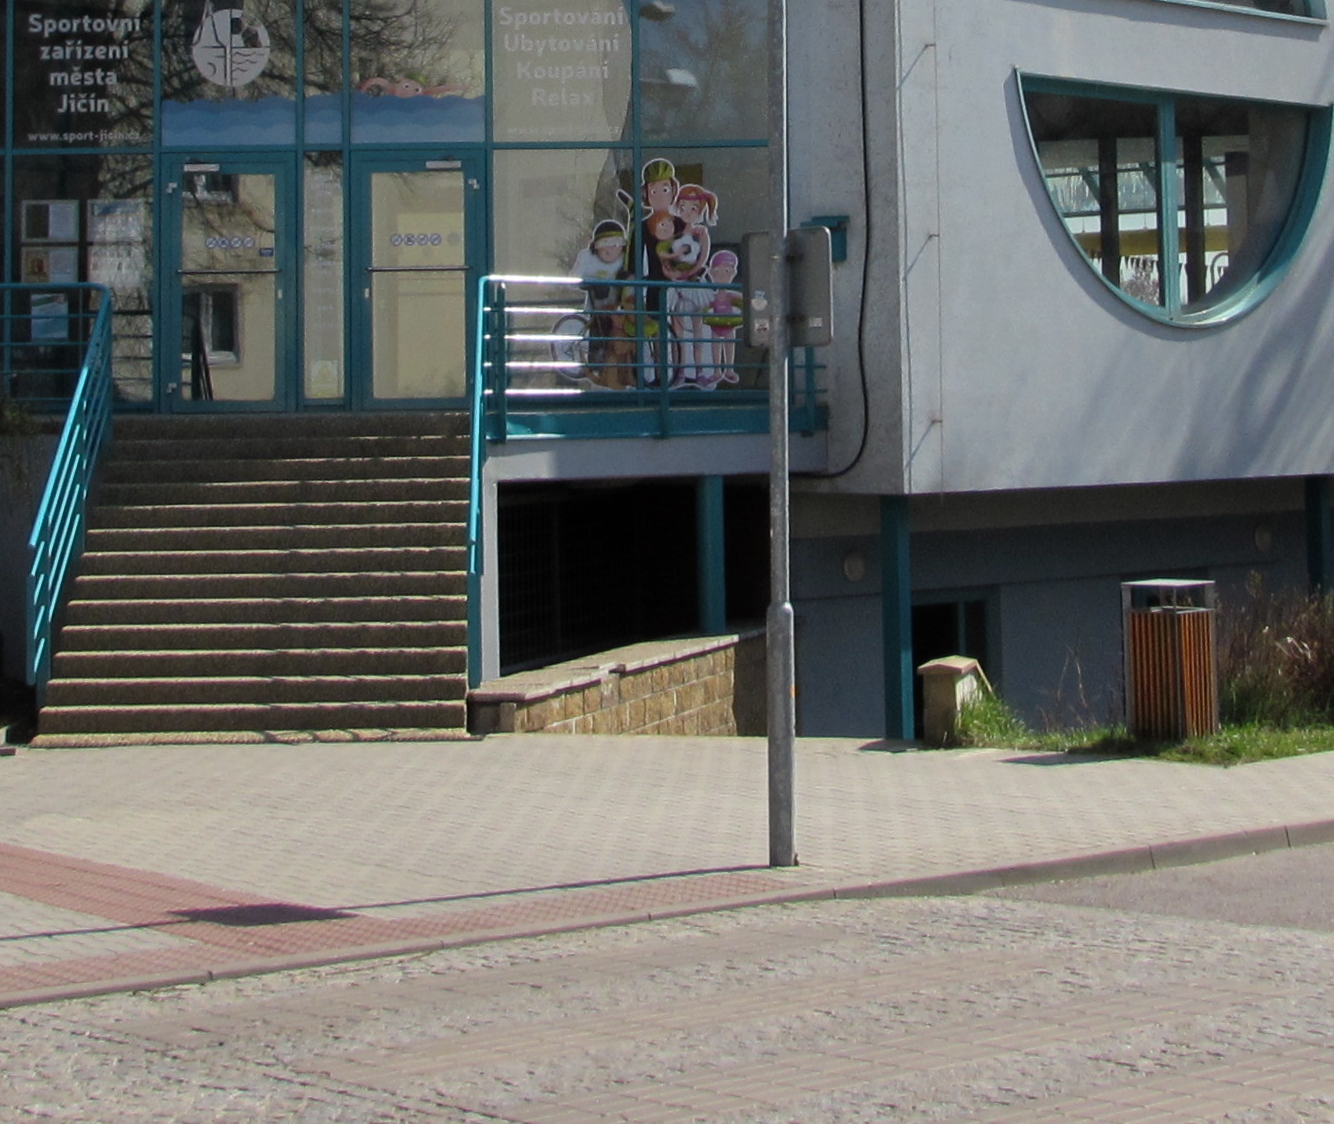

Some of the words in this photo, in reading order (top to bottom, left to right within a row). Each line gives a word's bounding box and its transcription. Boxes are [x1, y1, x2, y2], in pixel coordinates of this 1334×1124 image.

[28, 13, 141, 38] Sportovní
[498, 5, 625, 30] Sportování
[40, 39, 129, 60] zařízení
[504, 33, 620, 57] Ubytování
[49, 65, 119, 86] města
[516, 60, 610, 84] Koupání
[57, 92, 110, 114] Jičín
[531, 87, 596, 107] Relax
